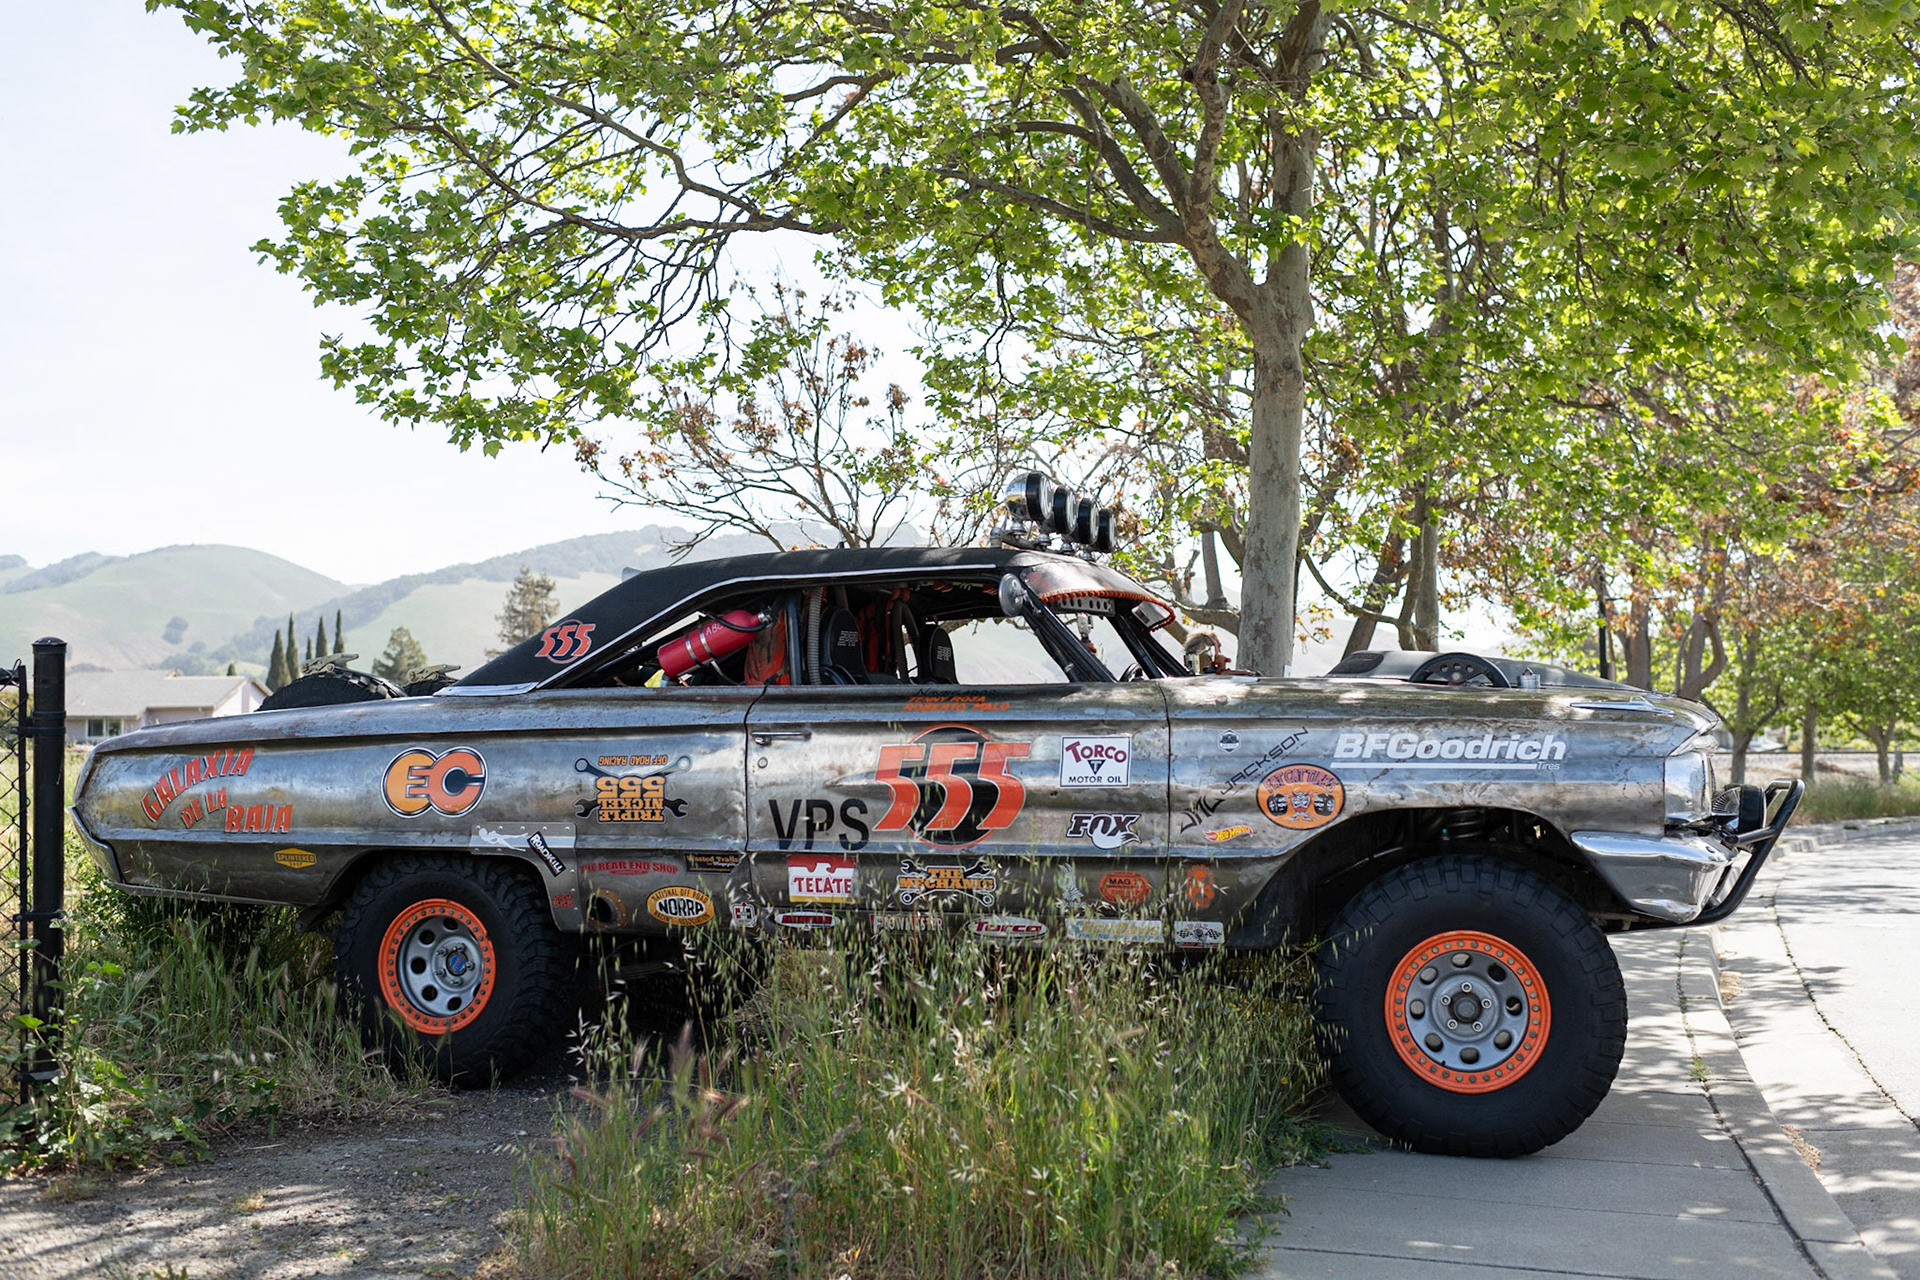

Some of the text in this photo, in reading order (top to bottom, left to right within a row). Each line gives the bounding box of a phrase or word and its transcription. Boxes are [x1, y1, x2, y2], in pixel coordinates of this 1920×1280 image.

[535, 623, 596, 657] 555
[1065, 741, 1127, 763] TORCO
[1334, 733, 1567, 760] BFGoodrich
[599, 755, 668, 766] OFF ROAD RACING
[1220, 726, 1309, 795] JACKSON
[1536, 762, 1560, 770] Tires
[140, 748, 255, 823] GALAXIA
[381, 746, 488, 818] EC
[596, 776, 666, 798] 555
[872, 741, 1031, 831] 555
[181, 787, 228, 829] DE LA
[597, 798, 664, 810] NICKEL
[224, 804, 293, 833] BAJA
[598, 810, 664, 821] TRIPLE
[769, 799, 869, 850] VPS
[1066, 813, 1141, 839] FOX
[529, 833, 564, 875] ROADKILL
[580, 863, 596, 875] THE
[598, 861, 627, 871] REAR
[629, 861, 650, 870] END
[652, 862, 678, 875] SHOP
[928, 868, 963, 878] THE
[793, 877, 852, 893] TECATE
[900, 877, 994, 890] MECHANIC
[658, 898, 704, 917] NORRA
[875, 915, 944, 931] FLOWMSTER
[975, 921, 1042, 933] Torco
